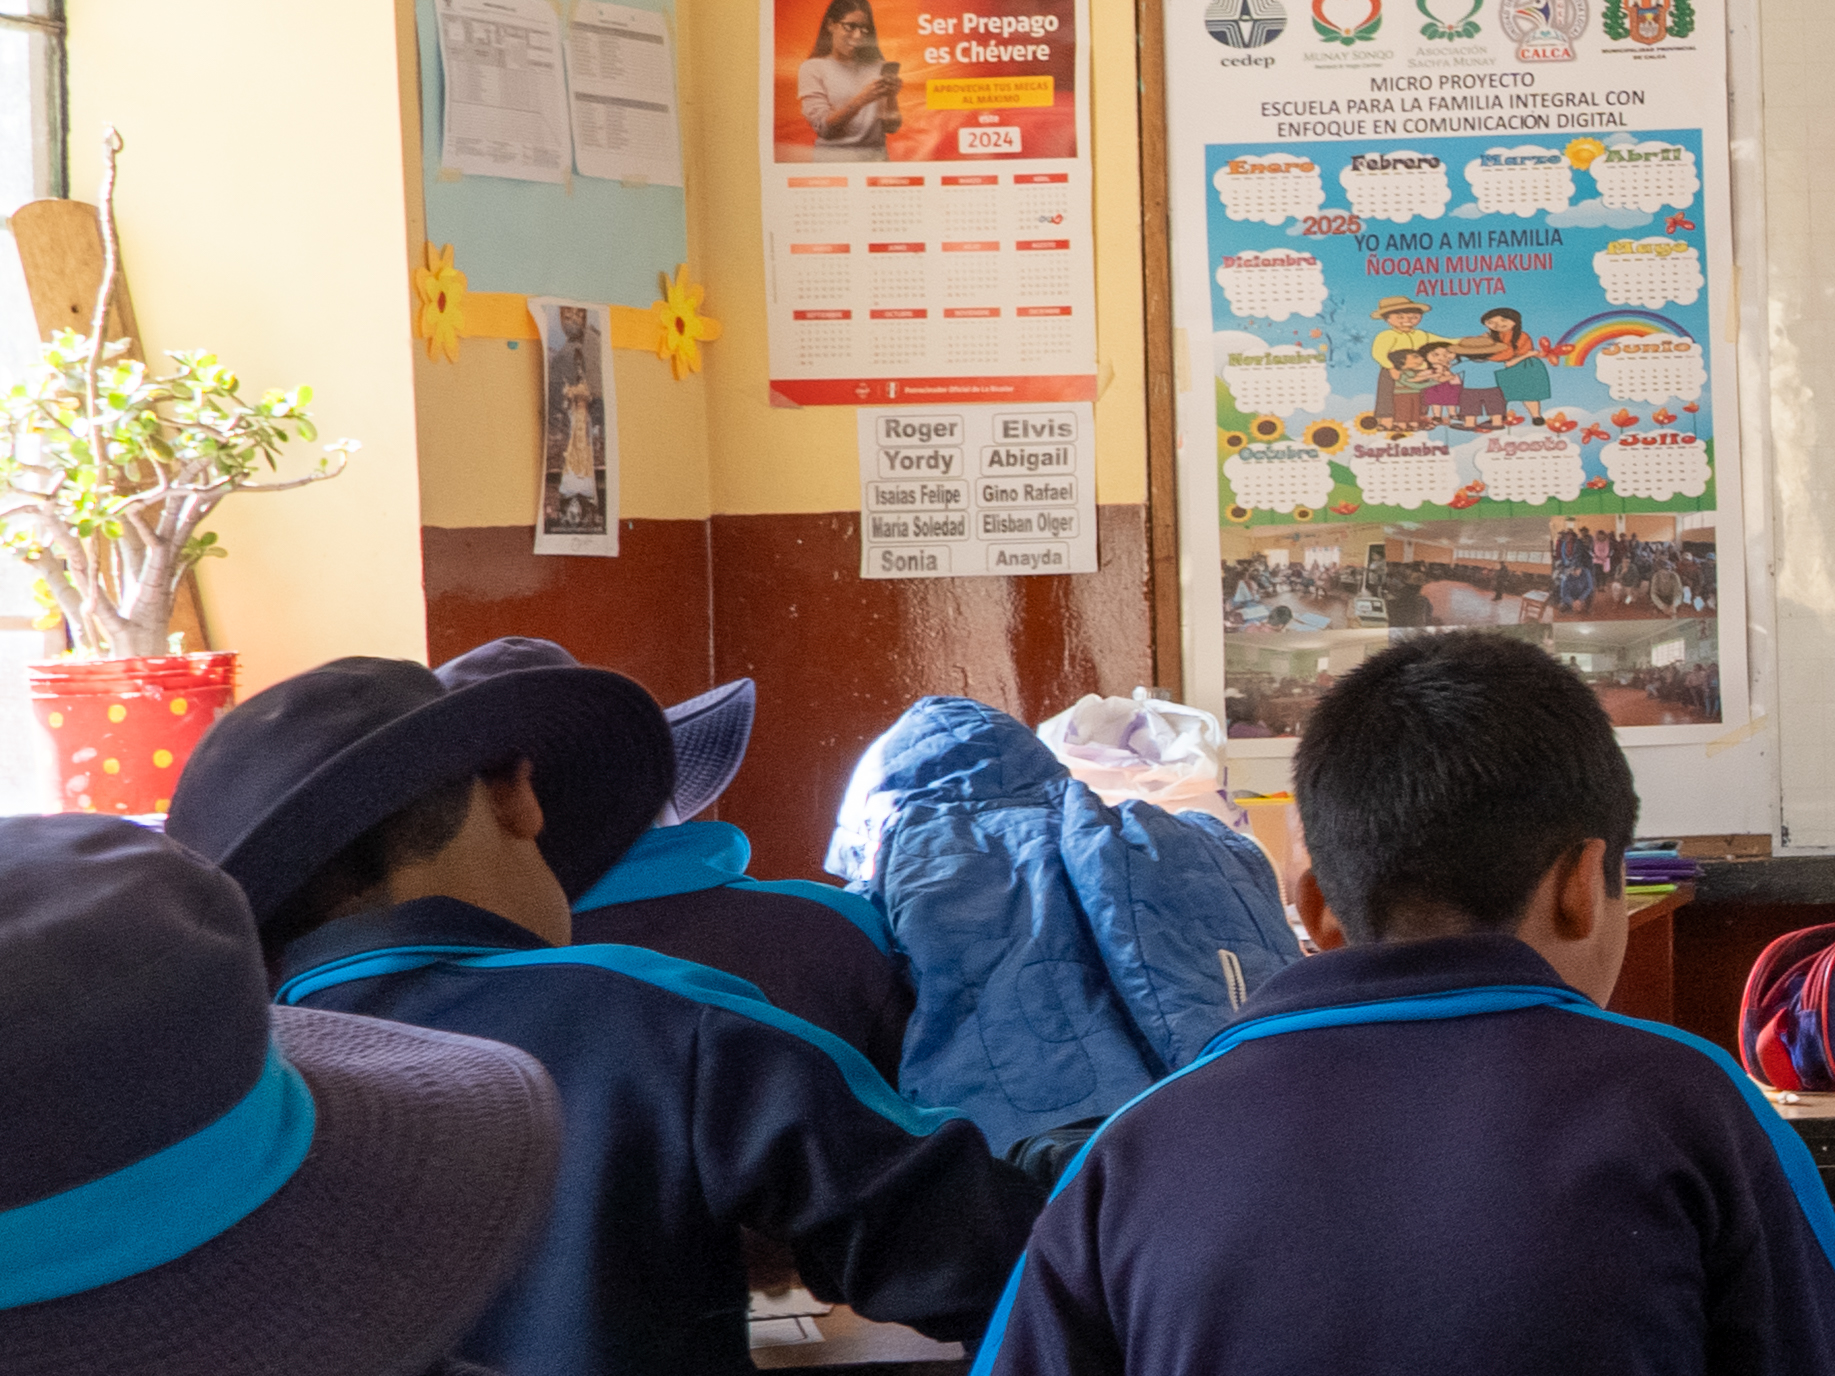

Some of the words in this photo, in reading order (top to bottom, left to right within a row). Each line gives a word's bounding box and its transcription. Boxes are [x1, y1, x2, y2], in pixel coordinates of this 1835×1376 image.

[918, 14, 957, 35] Ser
[963, 12, 1060, 38] Prepago
[924, 46, 951, 64] es
[956, 41, 1050, 63] Chévere
[1220, 55, 1276, 69] cedep
[1520, 48, 1571, 59] CALCA
[1370, 76, 1433, 93] MICRO
[1439, 72, 1535, 90] PROYECTO
[1261, 100, 1340, 117] ESCUELA
[1347, 98, 1395, 115] PARA
[1401, 96, 1423, 113] LA
[1428, 94, 1504, 111] FAMILIA
[1510, 91, 1600, 109] INTEGRAL
[1605, 90, 1646, 106] CON
[1278, 120, 1366, 138] ENFOQUE
[1374, 119, 1397, 135] EN
[1403, 111, 1550, 134] COMUNICACIÓN
[1556, 111, 1627, 129] DIGITAL
[968, 131, 1013, 149] 2024
[1227, 160, 1316, 174] Enero
[1351, 155, 1441, 172] Febrero
[1480, 154, 1562, 167] Marzo
[1302, 215, 1362, 236] 2025
[1354, 233, 1380, 252] YO
[1385, 232, 1434, 251] AMO
[1439, 232, 1453, 250] A
[1458, 231, 1482, 250] MI
[1488, 228, 1564, 247] FAMILIA
[1366, 253, 1440, 277] ÑOQAN
[1445, 253, 1553, 274] MUNAKUNI
[1415, 277, 1506, 297] AYLLUYTA
[884, 419, 958, 443] Roger
[1002, 419, 1073, 439] Elvis
[1486, 437, 1568, 456] Agosto
[884, 449, 954, 475] Yordy
[988, 447, 1068, 471] Abigail
[921, 484, 961, 510] Felipe
[983, 485, 1018, 503] Gino
[1024, 481, 1073, 502] Rafael
[913, 514, 965, 538] Soledad
[983, 512, 1033, 534] Elisban
[1037, 511, 1074, 536] Olger
[881, 549, 938, 572] Sonia
[996, 549, 1063, 570] Anayda
